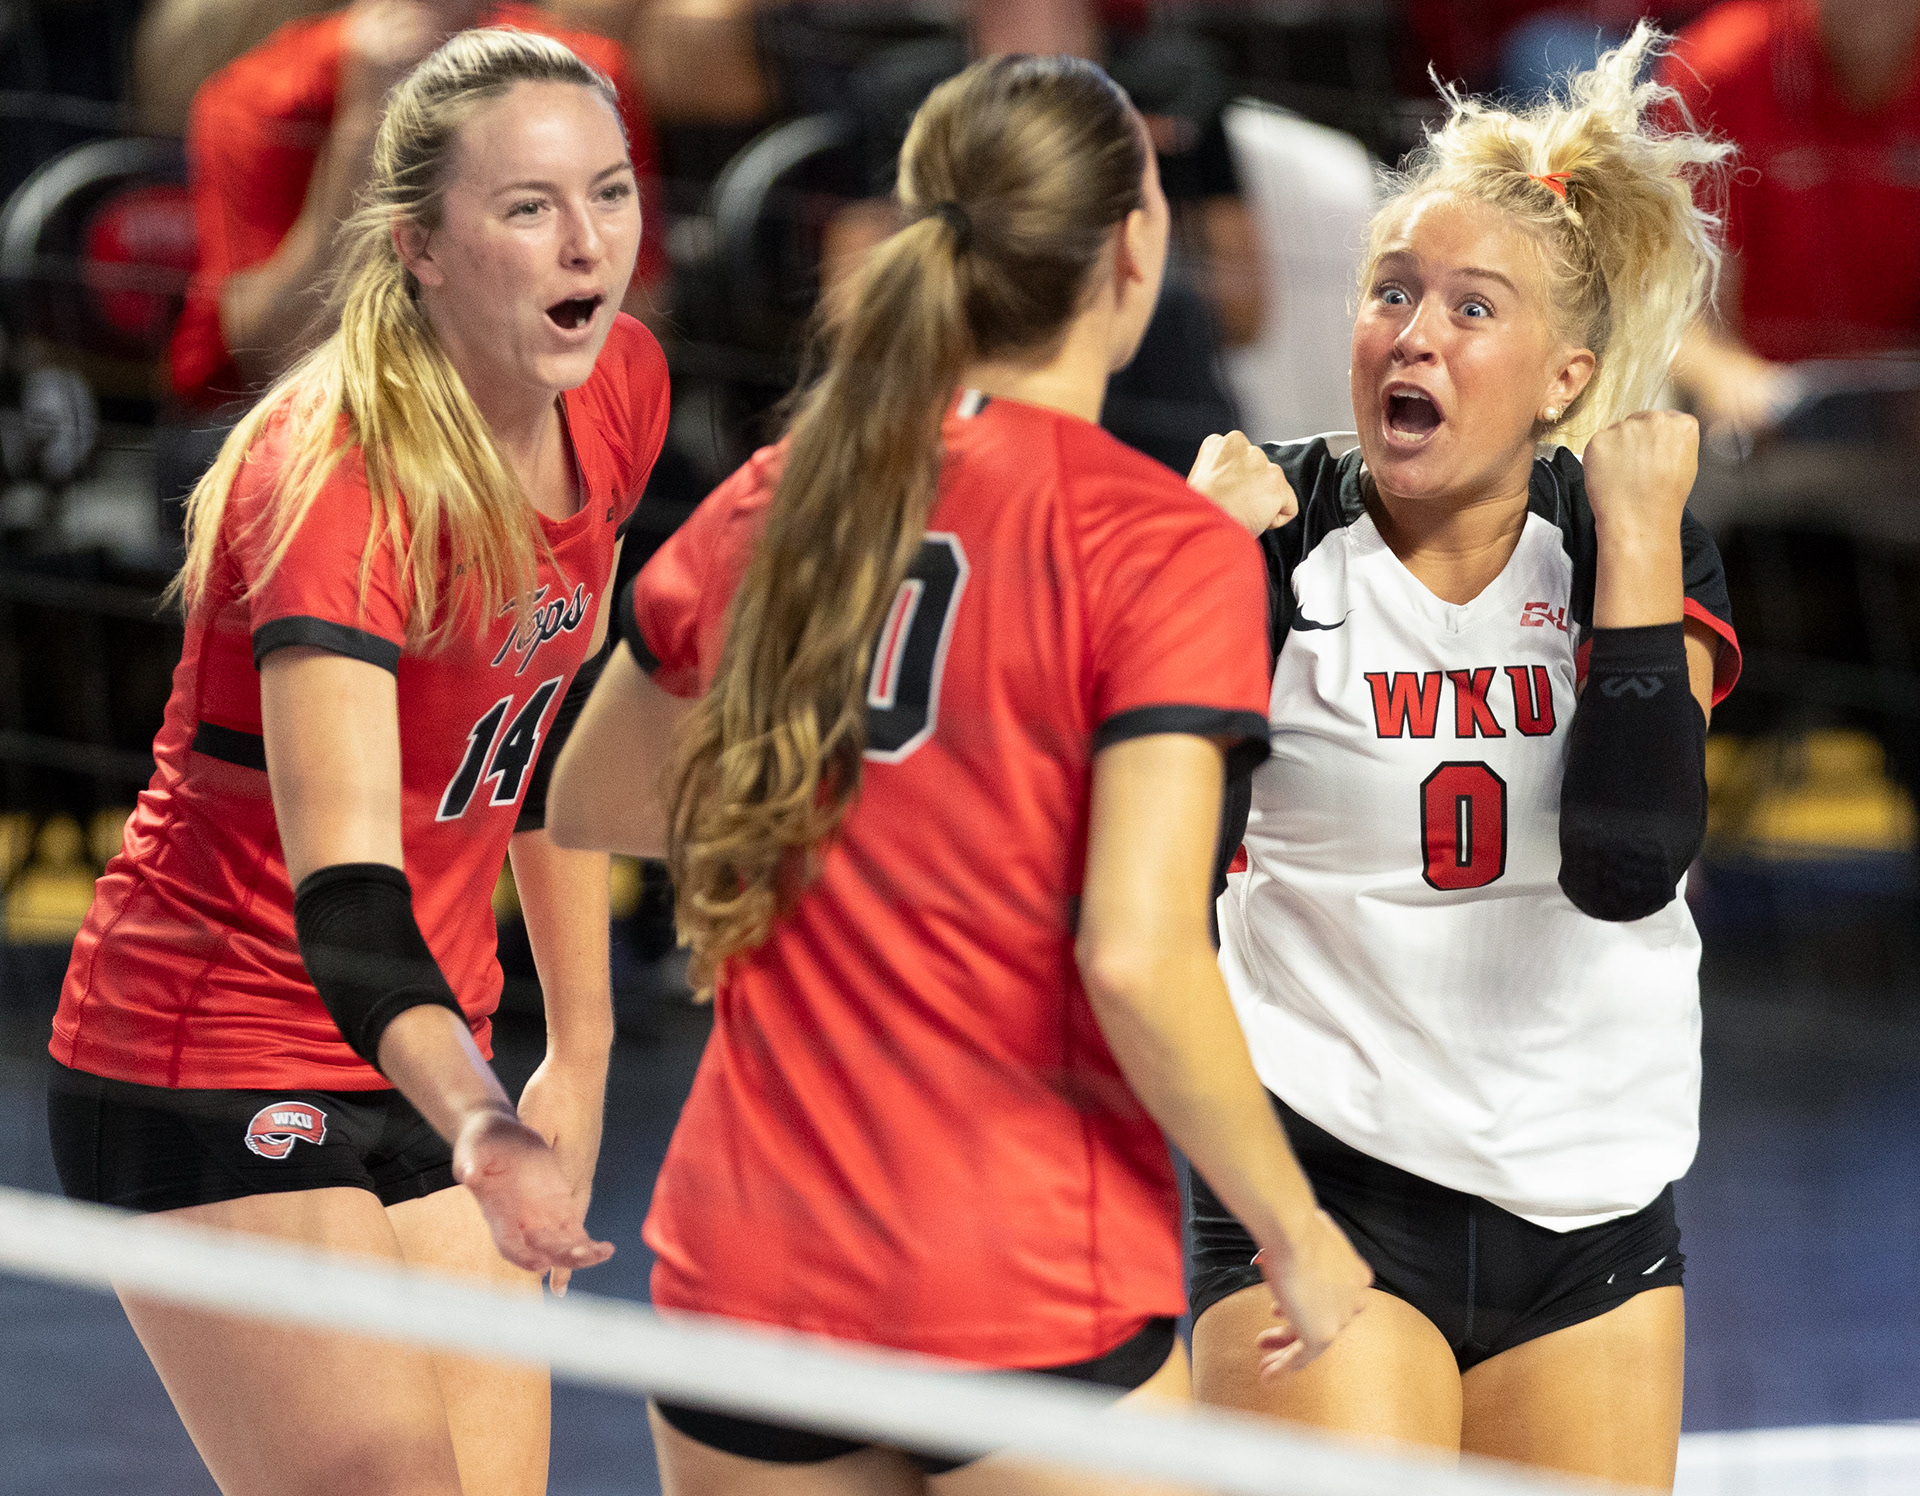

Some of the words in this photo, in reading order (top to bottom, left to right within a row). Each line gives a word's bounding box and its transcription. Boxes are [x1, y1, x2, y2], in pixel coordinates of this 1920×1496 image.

[490, 582, 593, 677] Tops
[434, 675, 564, 821] 14
[1364, 665, 1556, 739] WKU
[1420, 761, 1507, 891] 0
[271, 1111, 313, 1130] WKU
